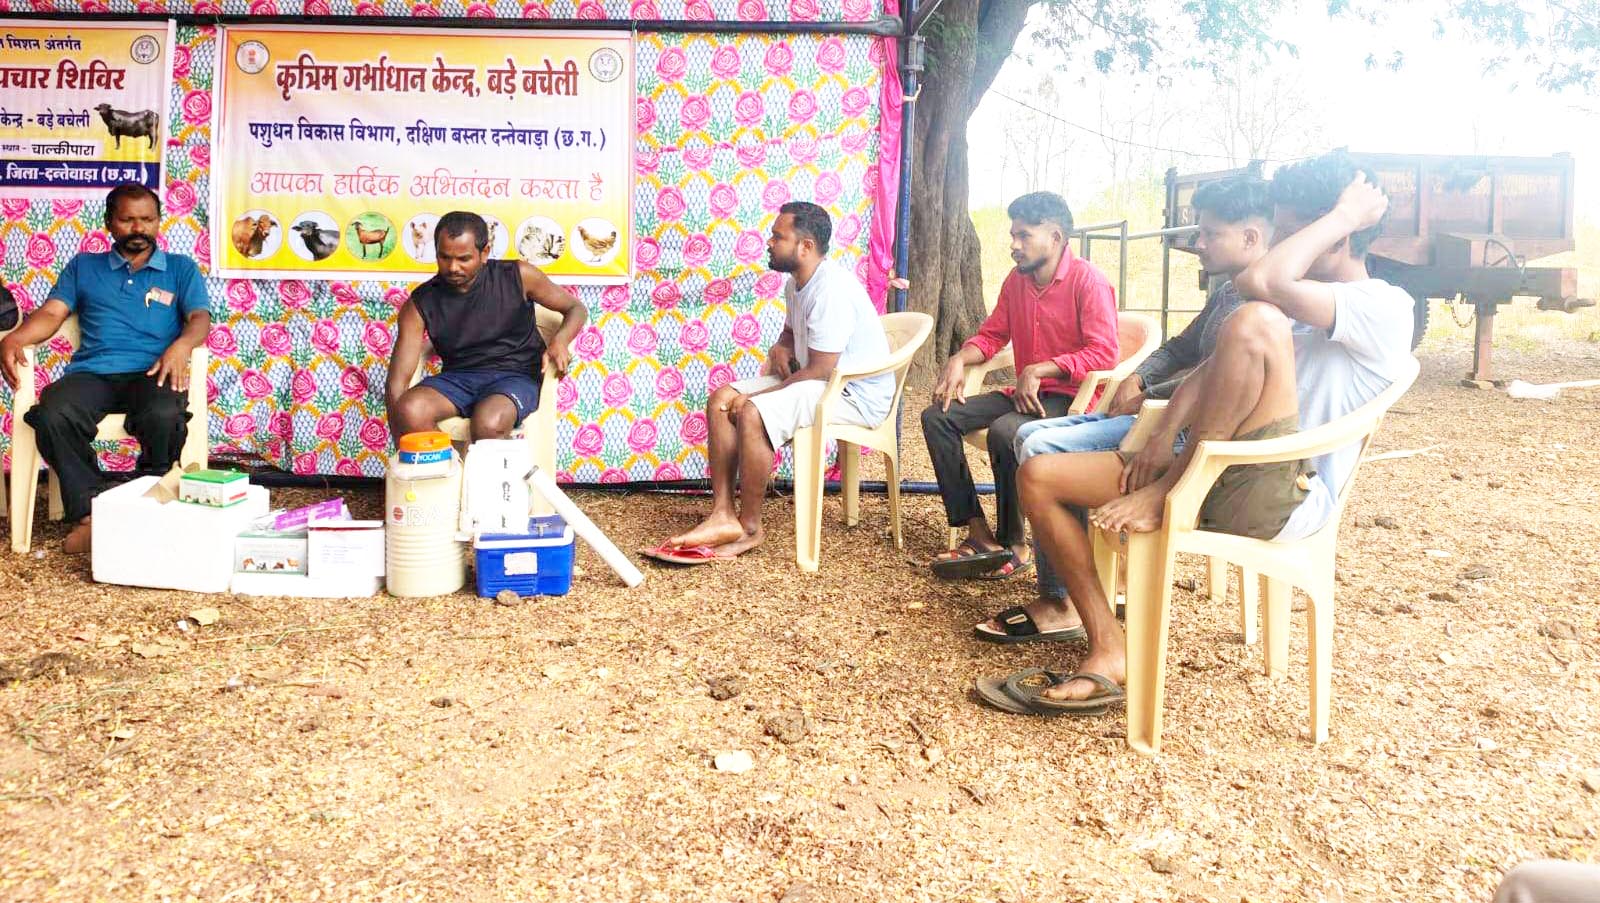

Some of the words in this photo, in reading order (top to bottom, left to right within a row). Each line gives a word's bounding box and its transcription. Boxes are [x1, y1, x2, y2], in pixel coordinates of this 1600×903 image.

[6, 34, 41, 50] मिशन
[45, 35, 81, 50] अंतर्गत
[56, 59, 126, 90] शिविर
[277, 53, 338, 101] कृत्रिम
[343, 56, 427, 92] गर्भाधान
[432, 57, 480, 97] केन्द्र,
[487, 58, 517, 100] बड़े
[522, 59, 579, 96] बचेली
[0, 107, 23, 129] केन्द्र
[36, 107, 54, 130] बड़े
[56, 109, 90, 128] बचेली
[248, 122, 293, 148] पशुधन
[297, 116, 345, 141] विकास
[349, 118, 401, 145] विभाग,
[405, 119, 447, 145] दक्षिण
[451, 127, 487, 145] बस्तर
[491, 121, 548, 150] दन्तेवाड़ा
[554, 127, 606, 151] (छ.ग.)
[101, 166, 148, 184] (छ.ग.)
[250, 171, 324, 194] आपका
[333, 165, 400, 196] हार्दिक
[410, 167, 511, 198] अभिनंदन
[520, 178, 580, 199] करता
[589, 172, 604, 200] है
